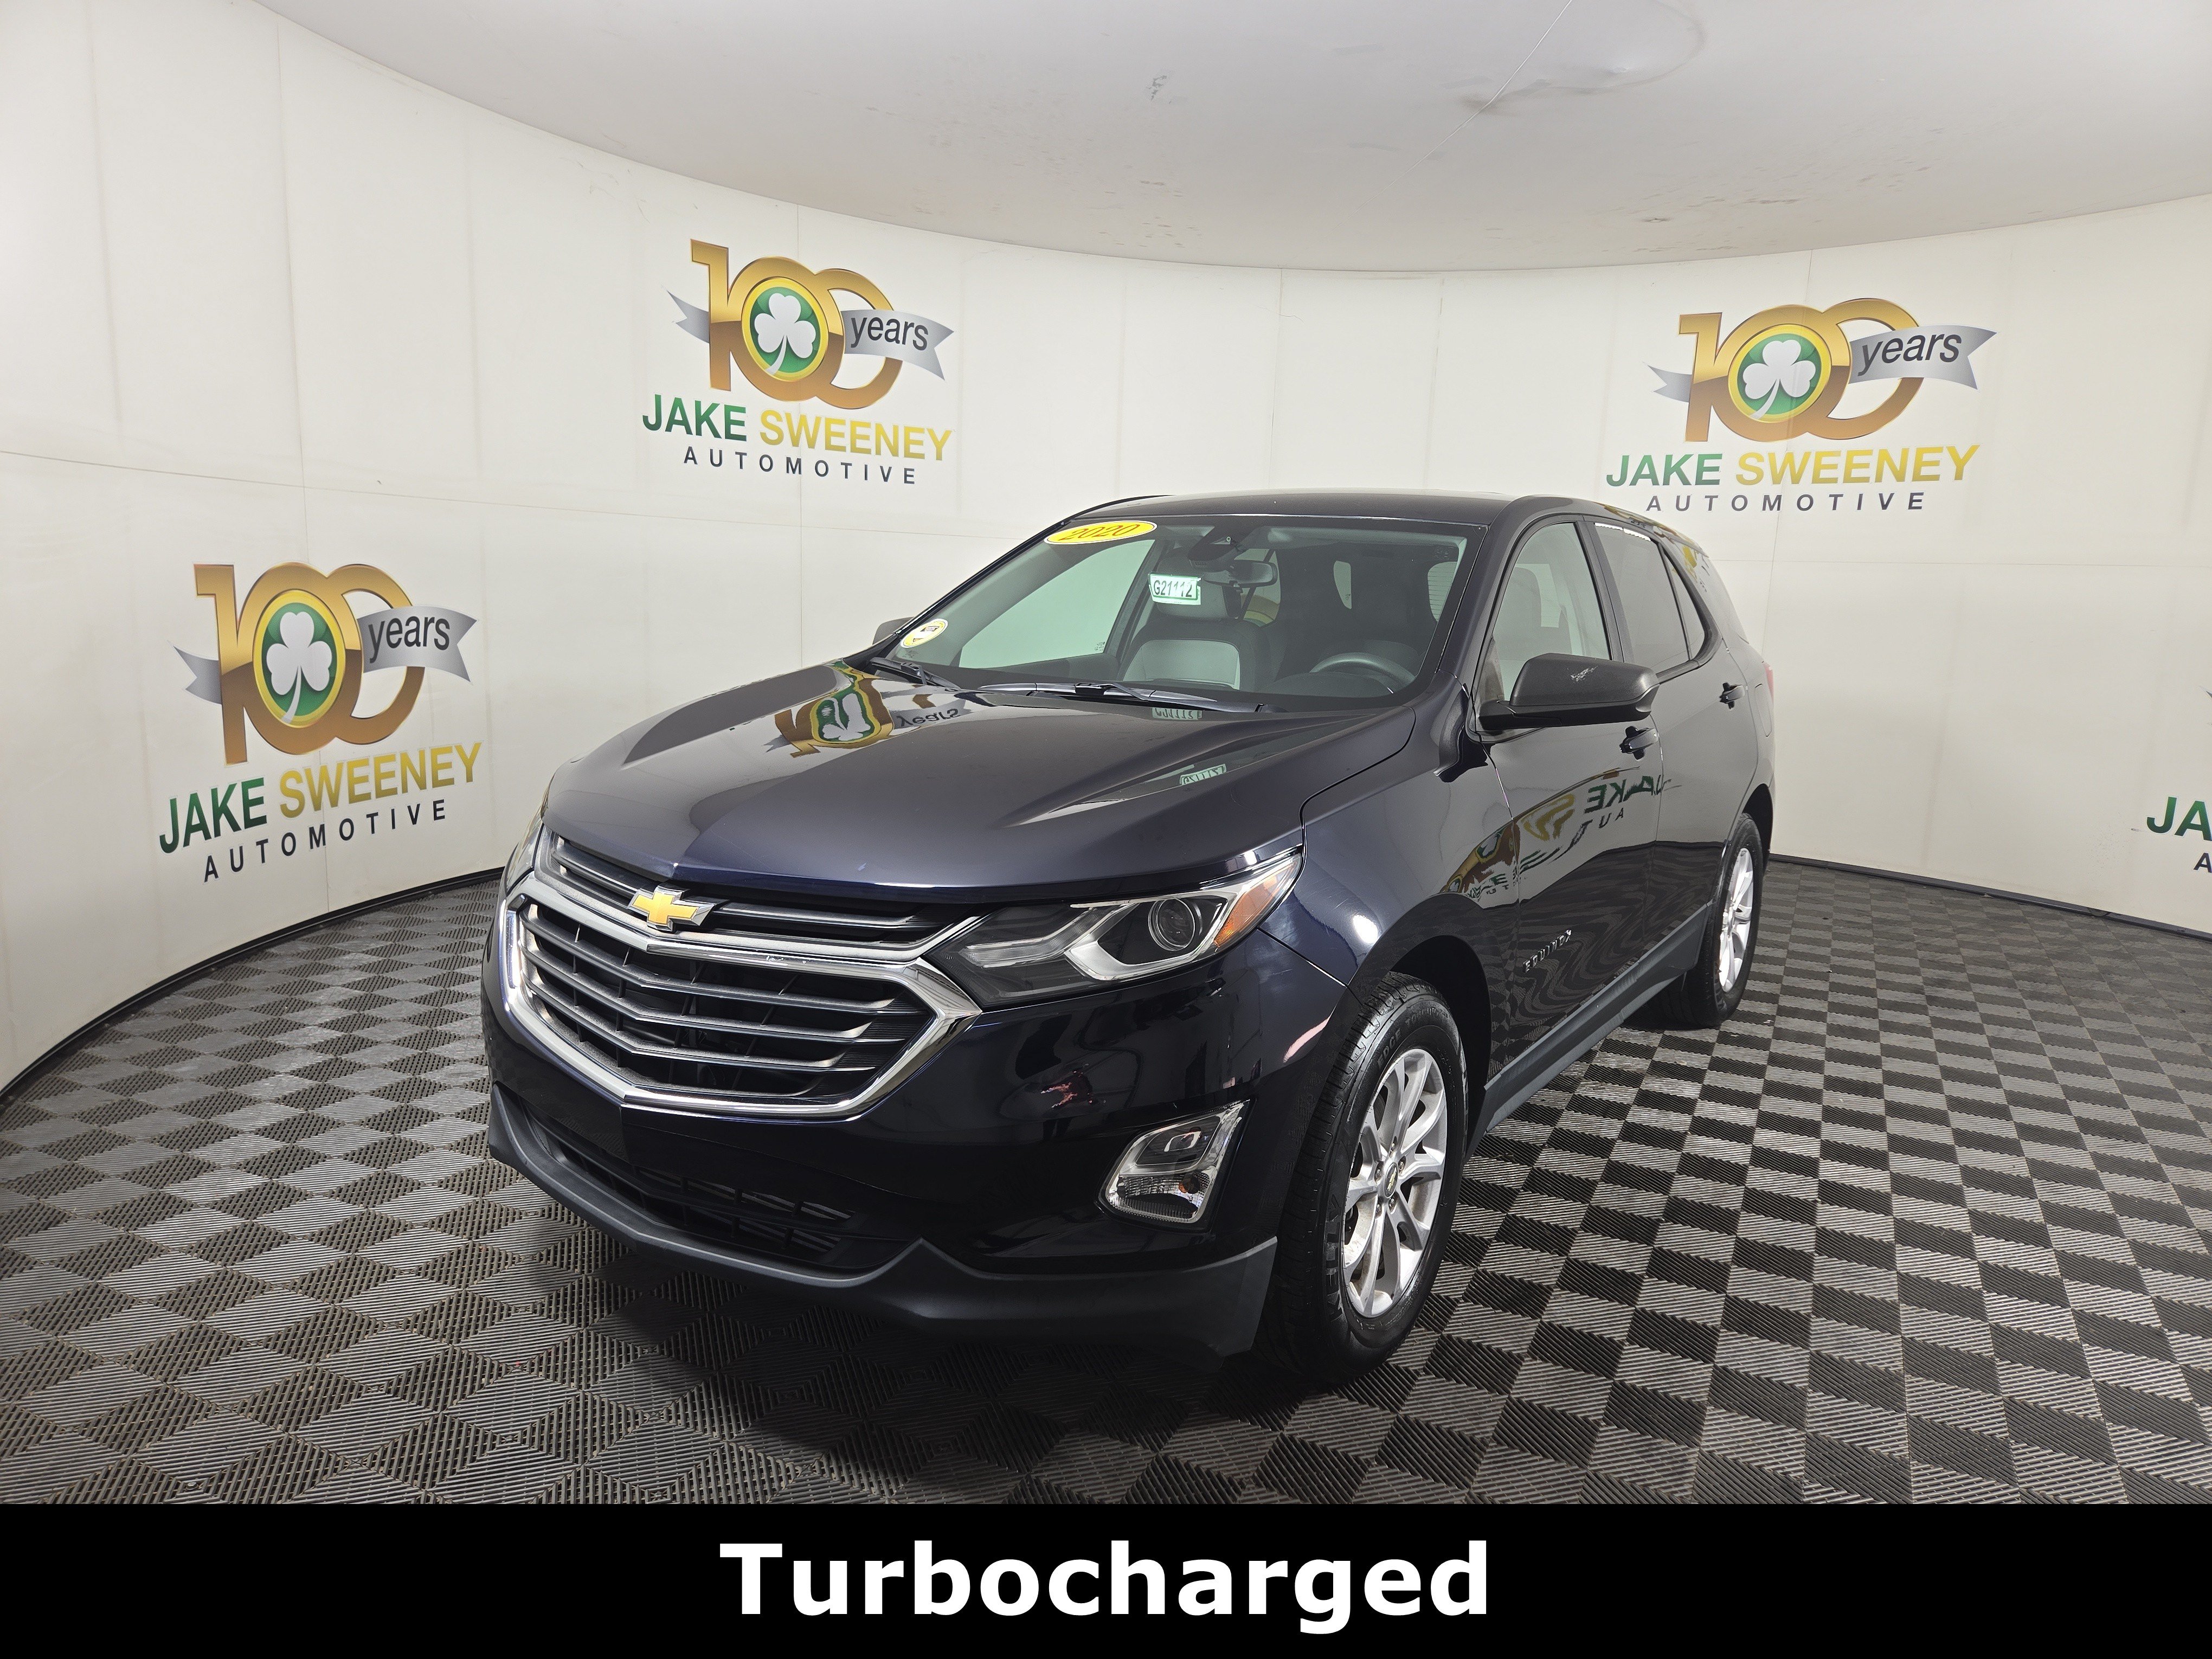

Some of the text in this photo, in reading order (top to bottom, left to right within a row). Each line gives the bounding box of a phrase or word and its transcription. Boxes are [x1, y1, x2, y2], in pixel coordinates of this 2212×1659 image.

[850, 315, 929, 350] years
[1857, 332, 1963, 376] years
[642, 394, 953, 461] JAKE SWEENEY
[684, 446, 915, 485] AUTOMOTIVE
[1606, 444, 1981, 487] JAKE SWEENEY
[1646, 492, 1925, 511] AUTOMOTIVE
[1058, 524, 1141, 541] 2020
[1153, 580, 1192, 597] G21112
[368, 616, 451, 663] years
[159, 742, 483, 853] JAKE SWEENEY
[204, 799, 446, 883] AUTOMOTIVE
